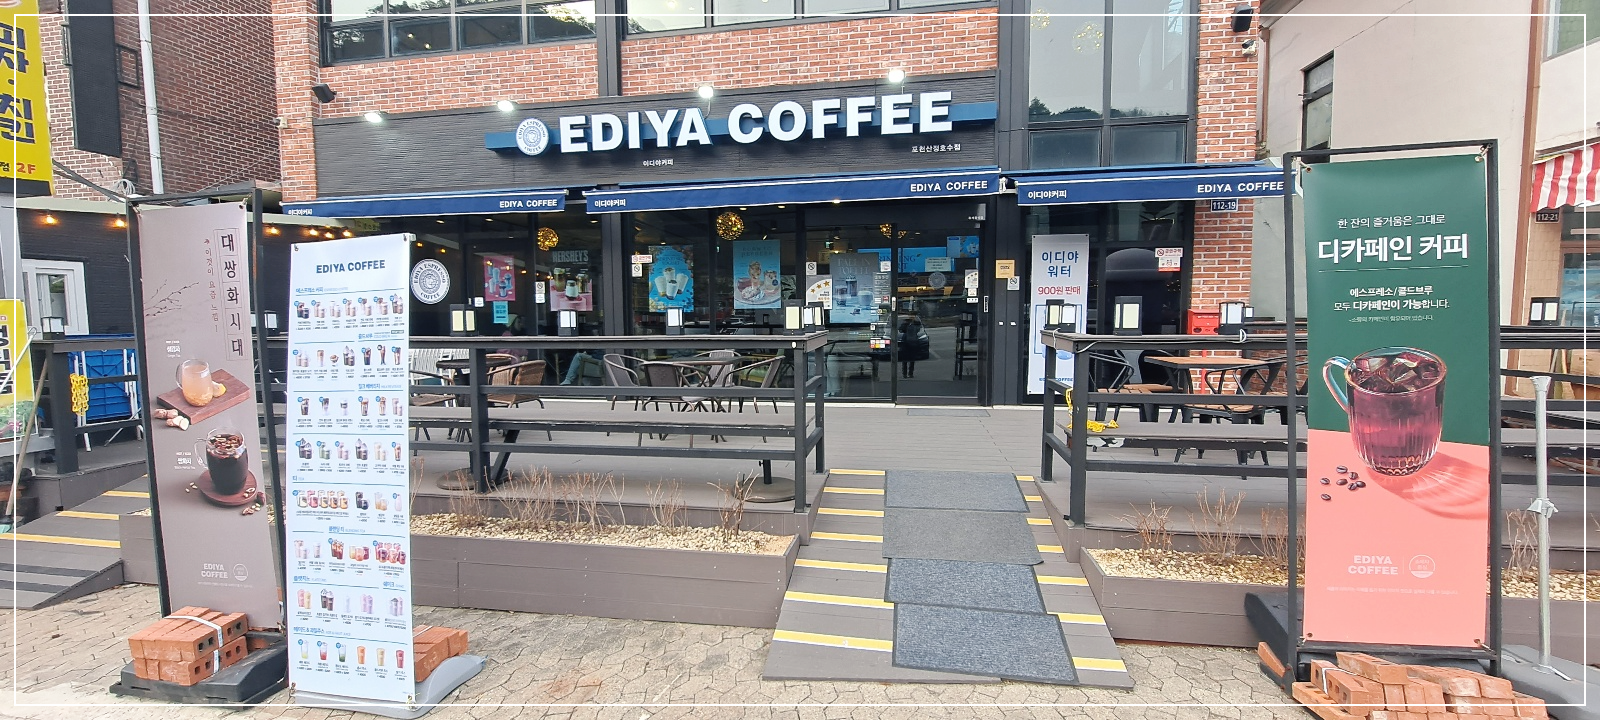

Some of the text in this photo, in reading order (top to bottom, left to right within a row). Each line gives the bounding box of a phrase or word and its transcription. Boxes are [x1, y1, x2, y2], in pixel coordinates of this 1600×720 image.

[559, 90, 954, 154] EDIYA COFFEE
[16, 162, 36, 175] 2F
[642, 158, 675, 168] 이디야커피
[910, 180, 988, 193] EDIYA COFFEE
[1197, 181, 1284, 194] EDIYA COFFEE
[1028, 189, 1067, 199] 이디야커피
[499, 198, 558, 209] EDIYA COFFEE
[594, 199, 627, 208] 이디야커피
[1212, 201, 1236, 210] 112-19
[1337, 214, 1446, 229] 한 잔의 즐거움은 그대로
[1537, 213, 1559, 221] 112-21
[1318, 233, 1469, 264] 디카페인 커피
[552, 249, 589, 263] HERSHEY'S
[1041, 250, 1079, 263] 이디야
[316, 259, 386, 274] EDIYA COFFEE
[1047, 264, 1072, 278] 워터
[1037, 286, 1081, 295] 900원 판매
[1333, 298, 1450, 312] 모두 디카페인이 가능합니다.
[1353, 555, 1393, 565] EDIYA
[203, 563, 225, 571] EDIYA
[1347, 565, 1399, 575] COFFEE
[201, 570, 229, 579] COFFEE
